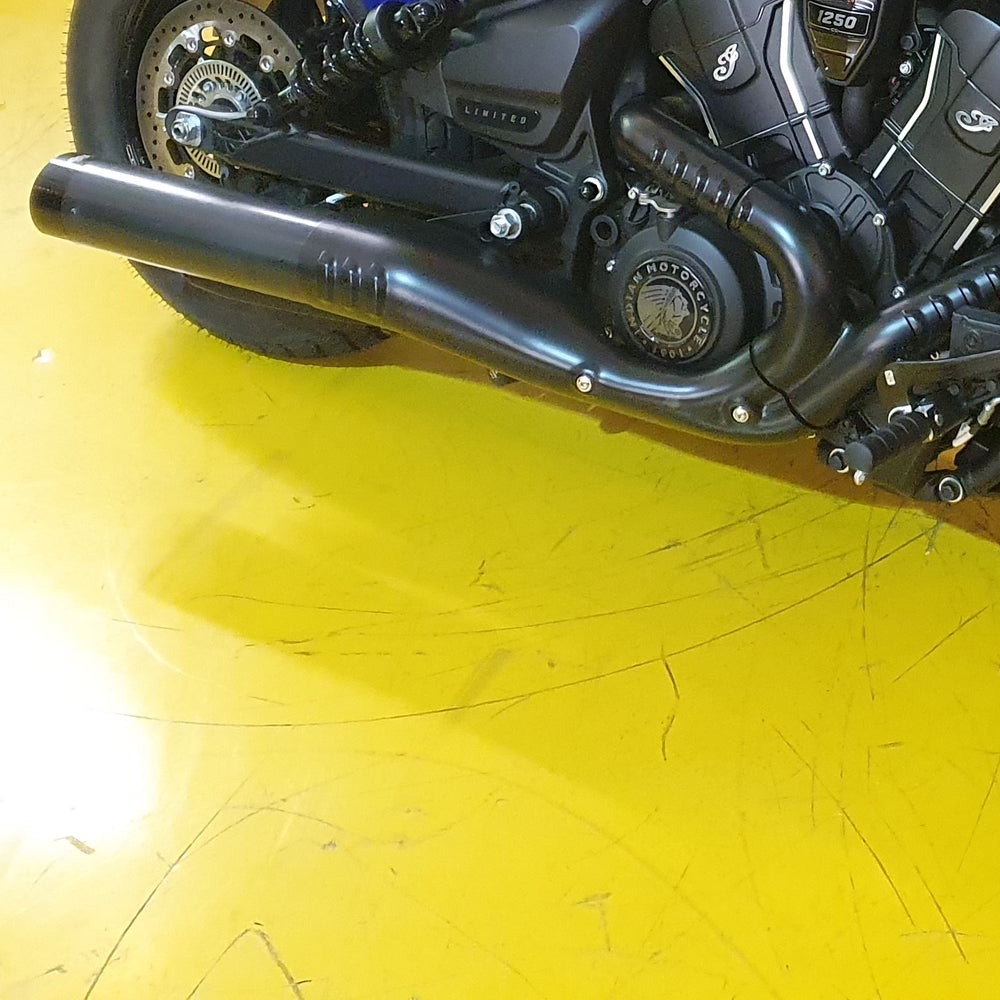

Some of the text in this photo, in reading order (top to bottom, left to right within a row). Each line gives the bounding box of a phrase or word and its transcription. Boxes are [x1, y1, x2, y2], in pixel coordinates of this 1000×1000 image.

[818, 9, 858, 30] 1250
[465, 105, 527, 124] LIMITED
[647, 262, 710, 346] MOTORCYCLE
